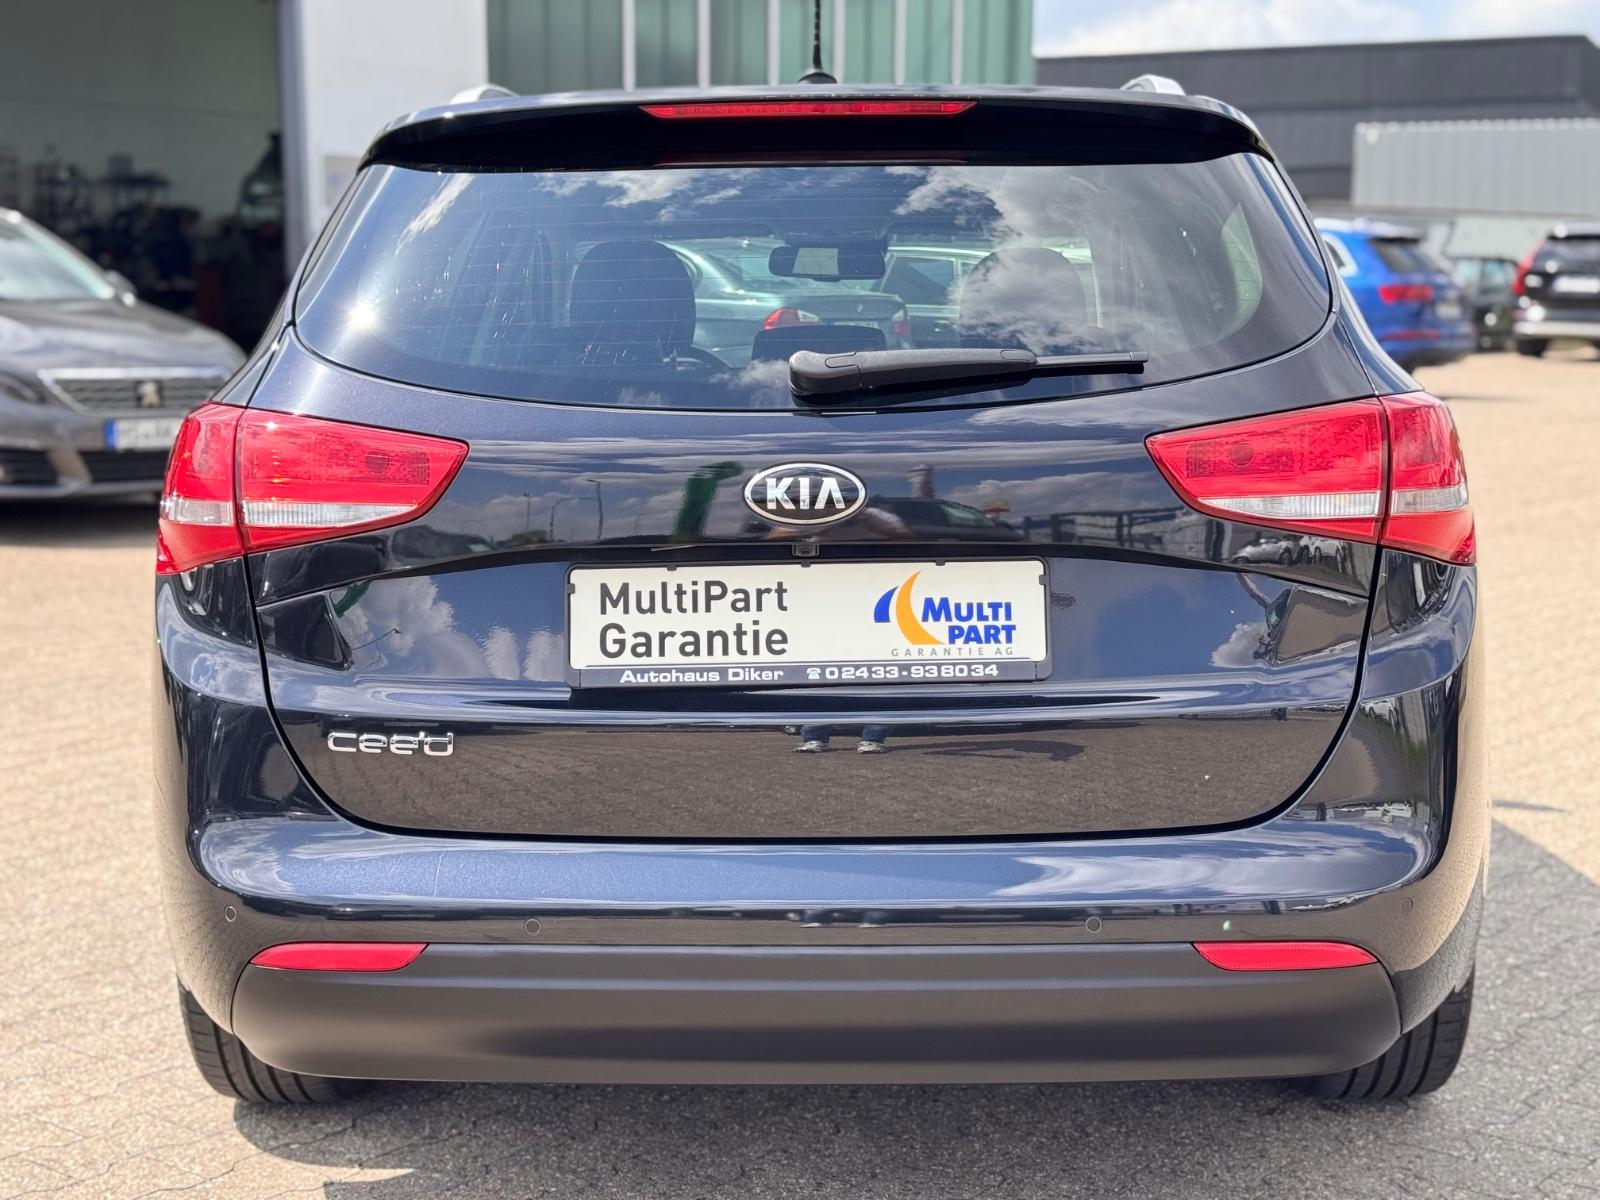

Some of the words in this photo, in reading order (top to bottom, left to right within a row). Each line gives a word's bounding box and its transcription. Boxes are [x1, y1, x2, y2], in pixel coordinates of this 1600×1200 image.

[765, 477, 846, 510] KIA
[600, 580, 788, 615] MultiPart
[921, 597, 1012, 622] MULTI
[600, 620, 788, 659] Garantie
[948, 624, 1016, 645] PART
[891, 647, 984, 657] GARANTIE
[995, 646, 1013, 656] AG
[619, 669, 720, 683] Autohaus
[727, 667, 784, 681] Diker
